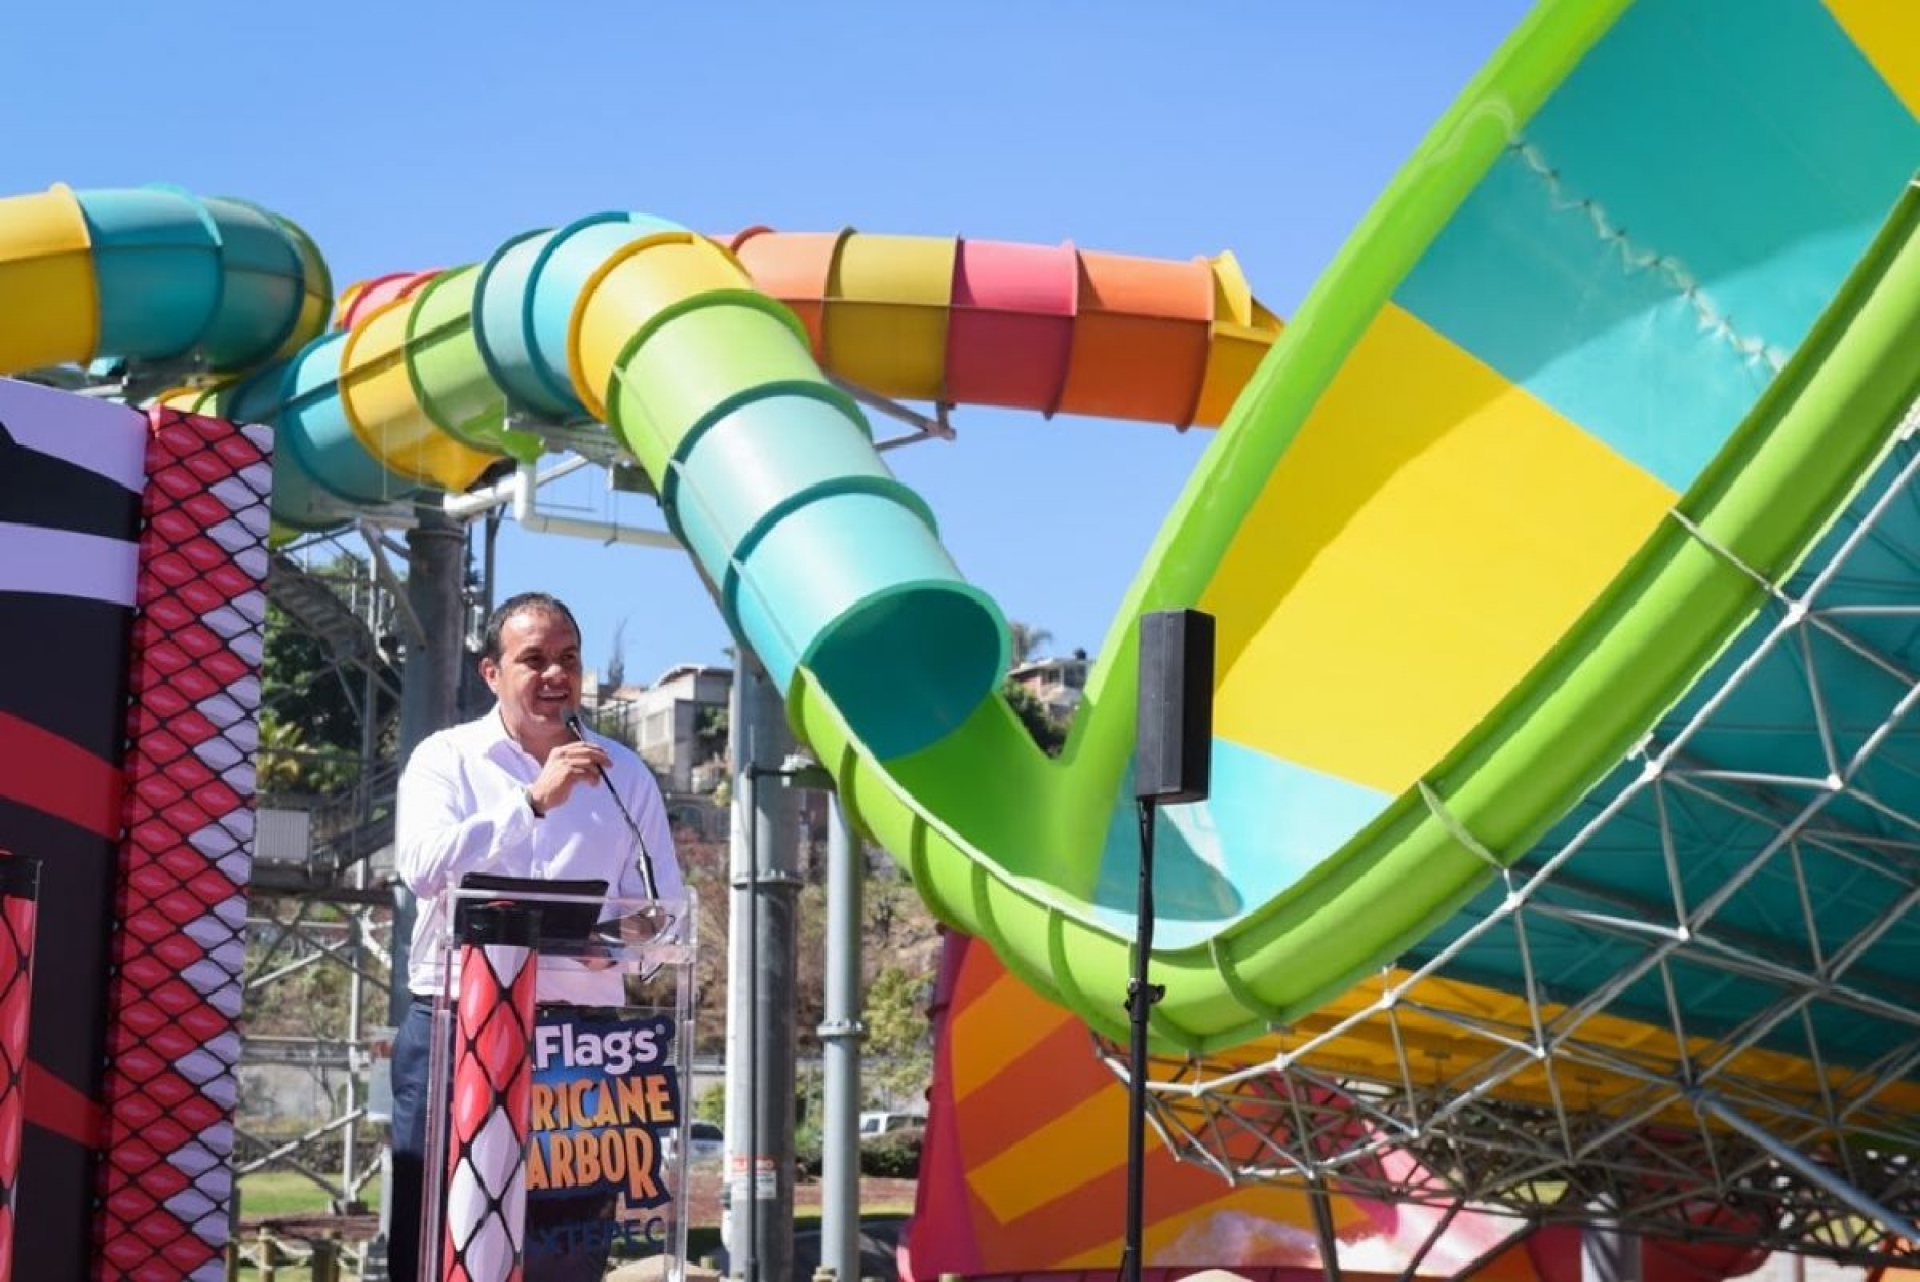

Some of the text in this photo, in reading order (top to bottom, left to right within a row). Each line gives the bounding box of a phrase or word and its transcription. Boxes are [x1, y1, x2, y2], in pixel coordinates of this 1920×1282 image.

[535, 1024, 658, 1074] Flags
[532, 1075, 674, 1130] RICANE
[526, 1128, 658, 1199] ARBOR
[529, 1216, 664, 1254] XTEPEC
